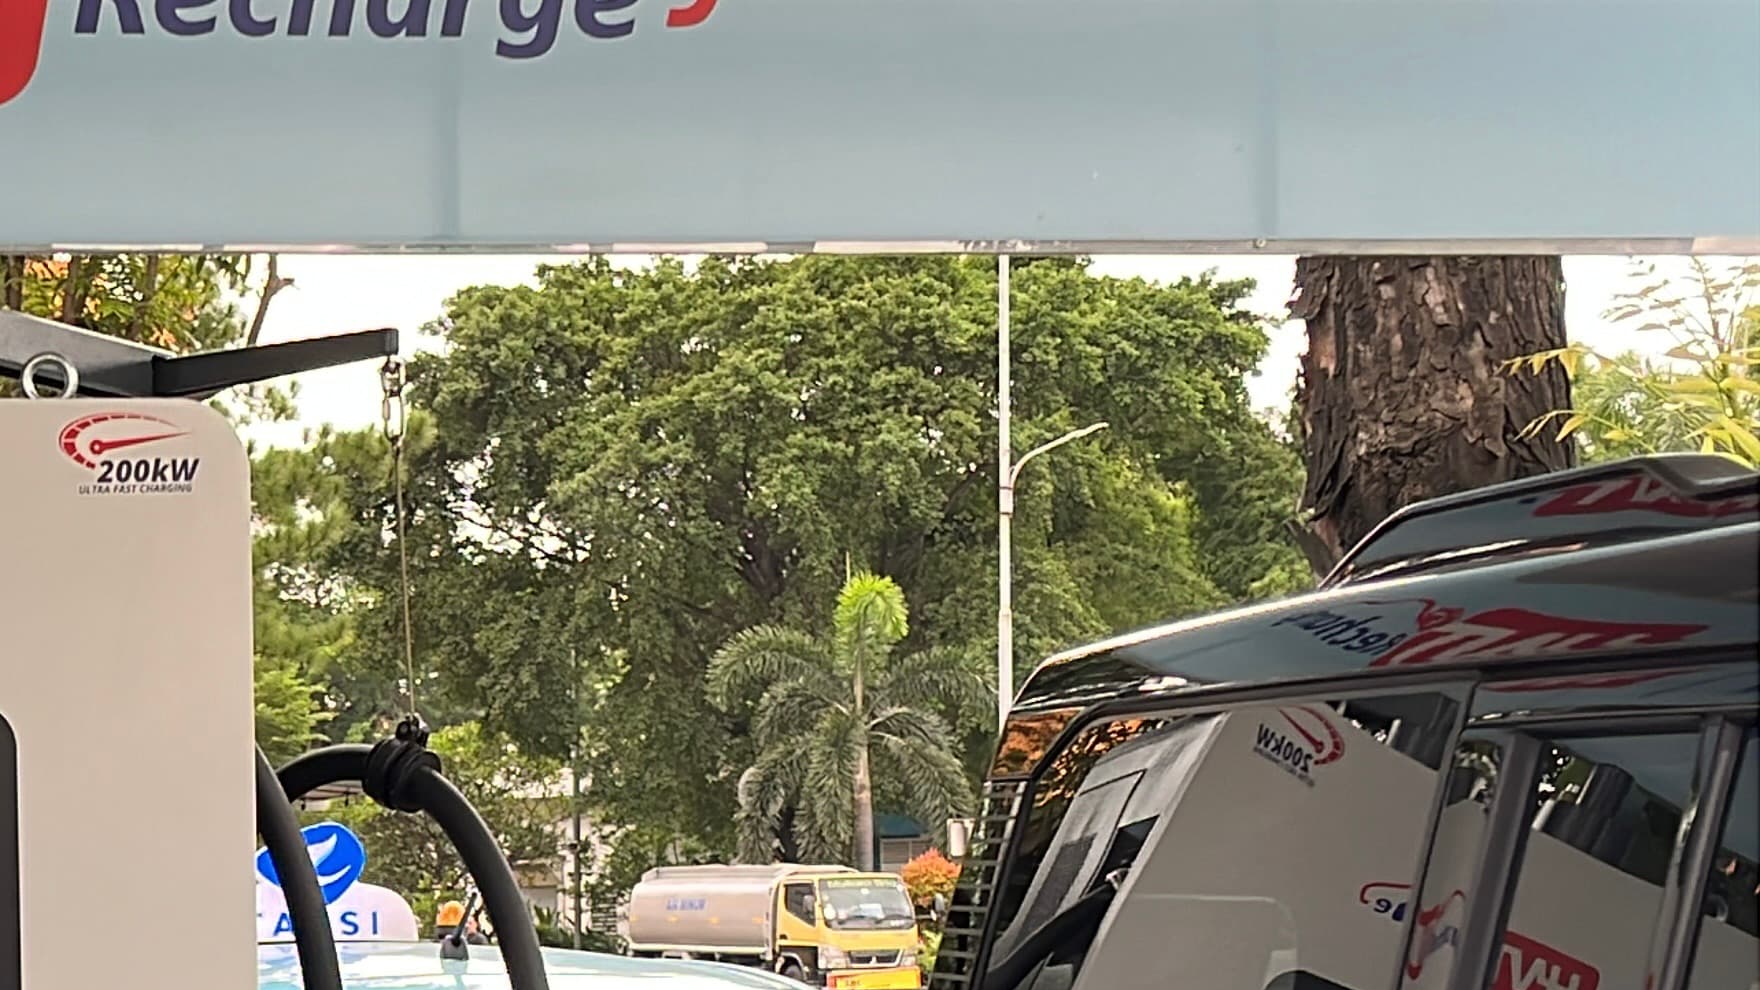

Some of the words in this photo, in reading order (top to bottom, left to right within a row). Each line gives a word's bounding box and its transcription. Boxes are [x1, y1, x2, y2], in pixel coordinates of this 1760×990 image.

[96, 458, 200, 484] 200kW
[79, 484, 111, 495] ULTRA
[113, 484, 136, 494] FAST
[139, 482, 193, 493] CHARGING
